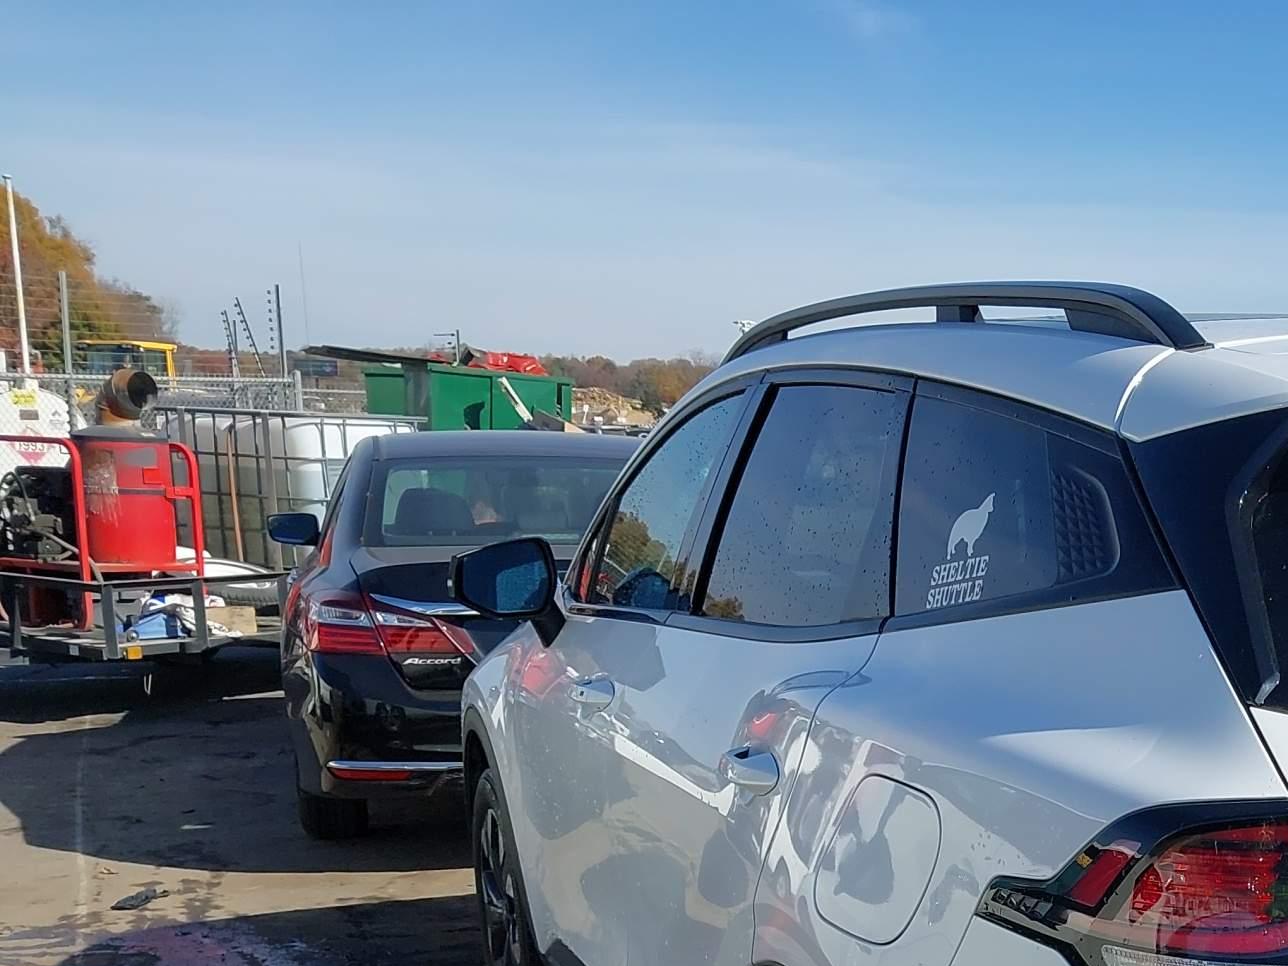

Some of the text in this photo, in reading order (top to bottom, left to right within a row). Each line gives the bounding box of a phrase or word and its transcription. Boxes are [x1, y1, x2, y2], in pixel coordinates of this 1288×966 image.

[930, 555, 990, 586] SHELTIE
[926, 580, 984, 609] SHUTTLE
[402, 656, 462, 666] Accord
